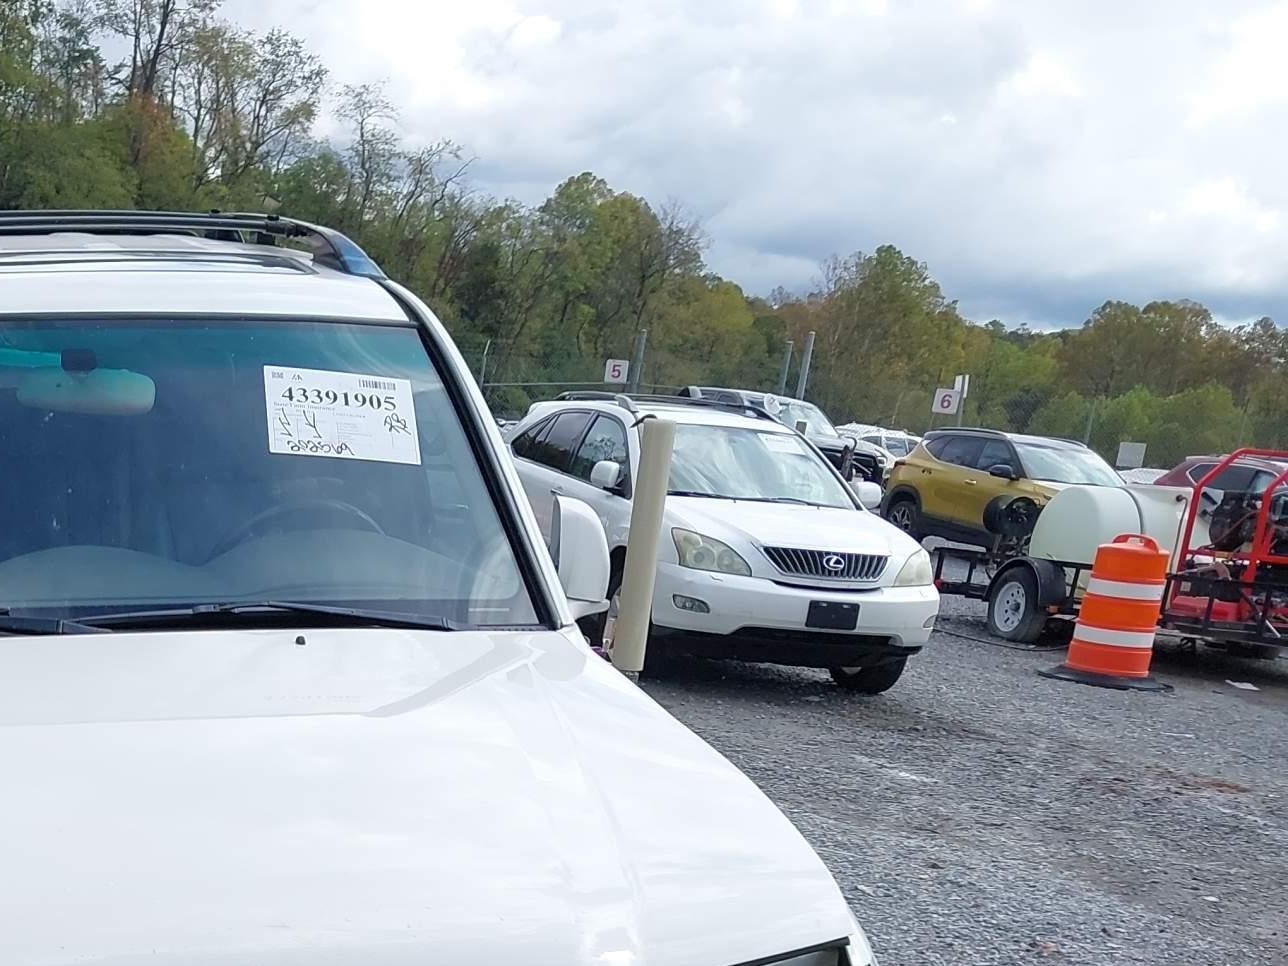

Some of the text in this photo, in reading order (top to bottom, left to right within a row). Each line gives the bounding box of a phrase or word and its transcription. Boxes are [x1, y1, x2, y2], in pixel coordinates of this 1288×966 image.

[611, 364, 623, 379] 5
[281, 386, 397, 412] 43391905
[940, 393, 953, 409] 6
